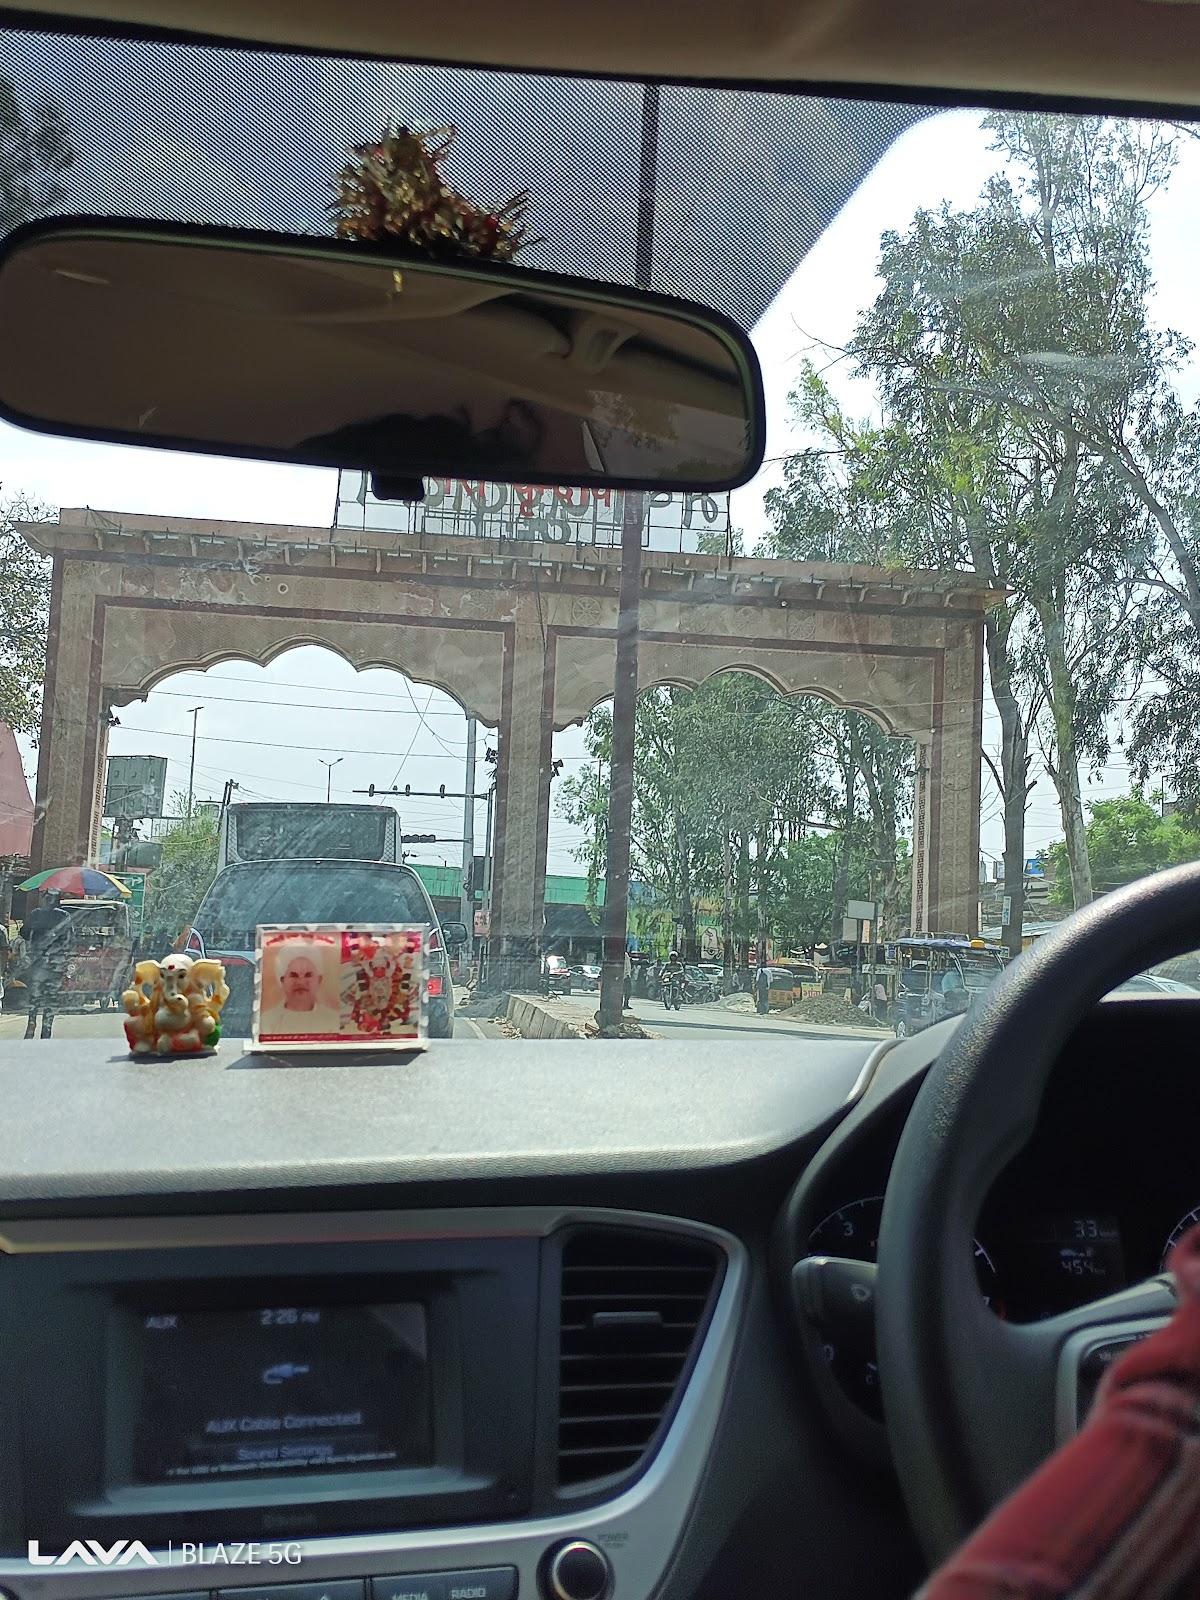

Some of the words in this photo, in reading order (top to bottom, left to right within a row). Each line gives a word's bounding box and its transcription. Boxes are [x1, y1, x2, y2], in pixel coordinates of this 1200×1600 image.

[843, 1222, 854, 1237] 3
[146, 1314, 177, 1329] AUX
[206, 1419, 237, 1433] AUX
[240, 1417, 280, 1431] Cable
[284, 1412, 361, 1429] Connected
[391, 1591, 429, 1600] MEDIA
[451, 1587, 487, 1599] RADIO
